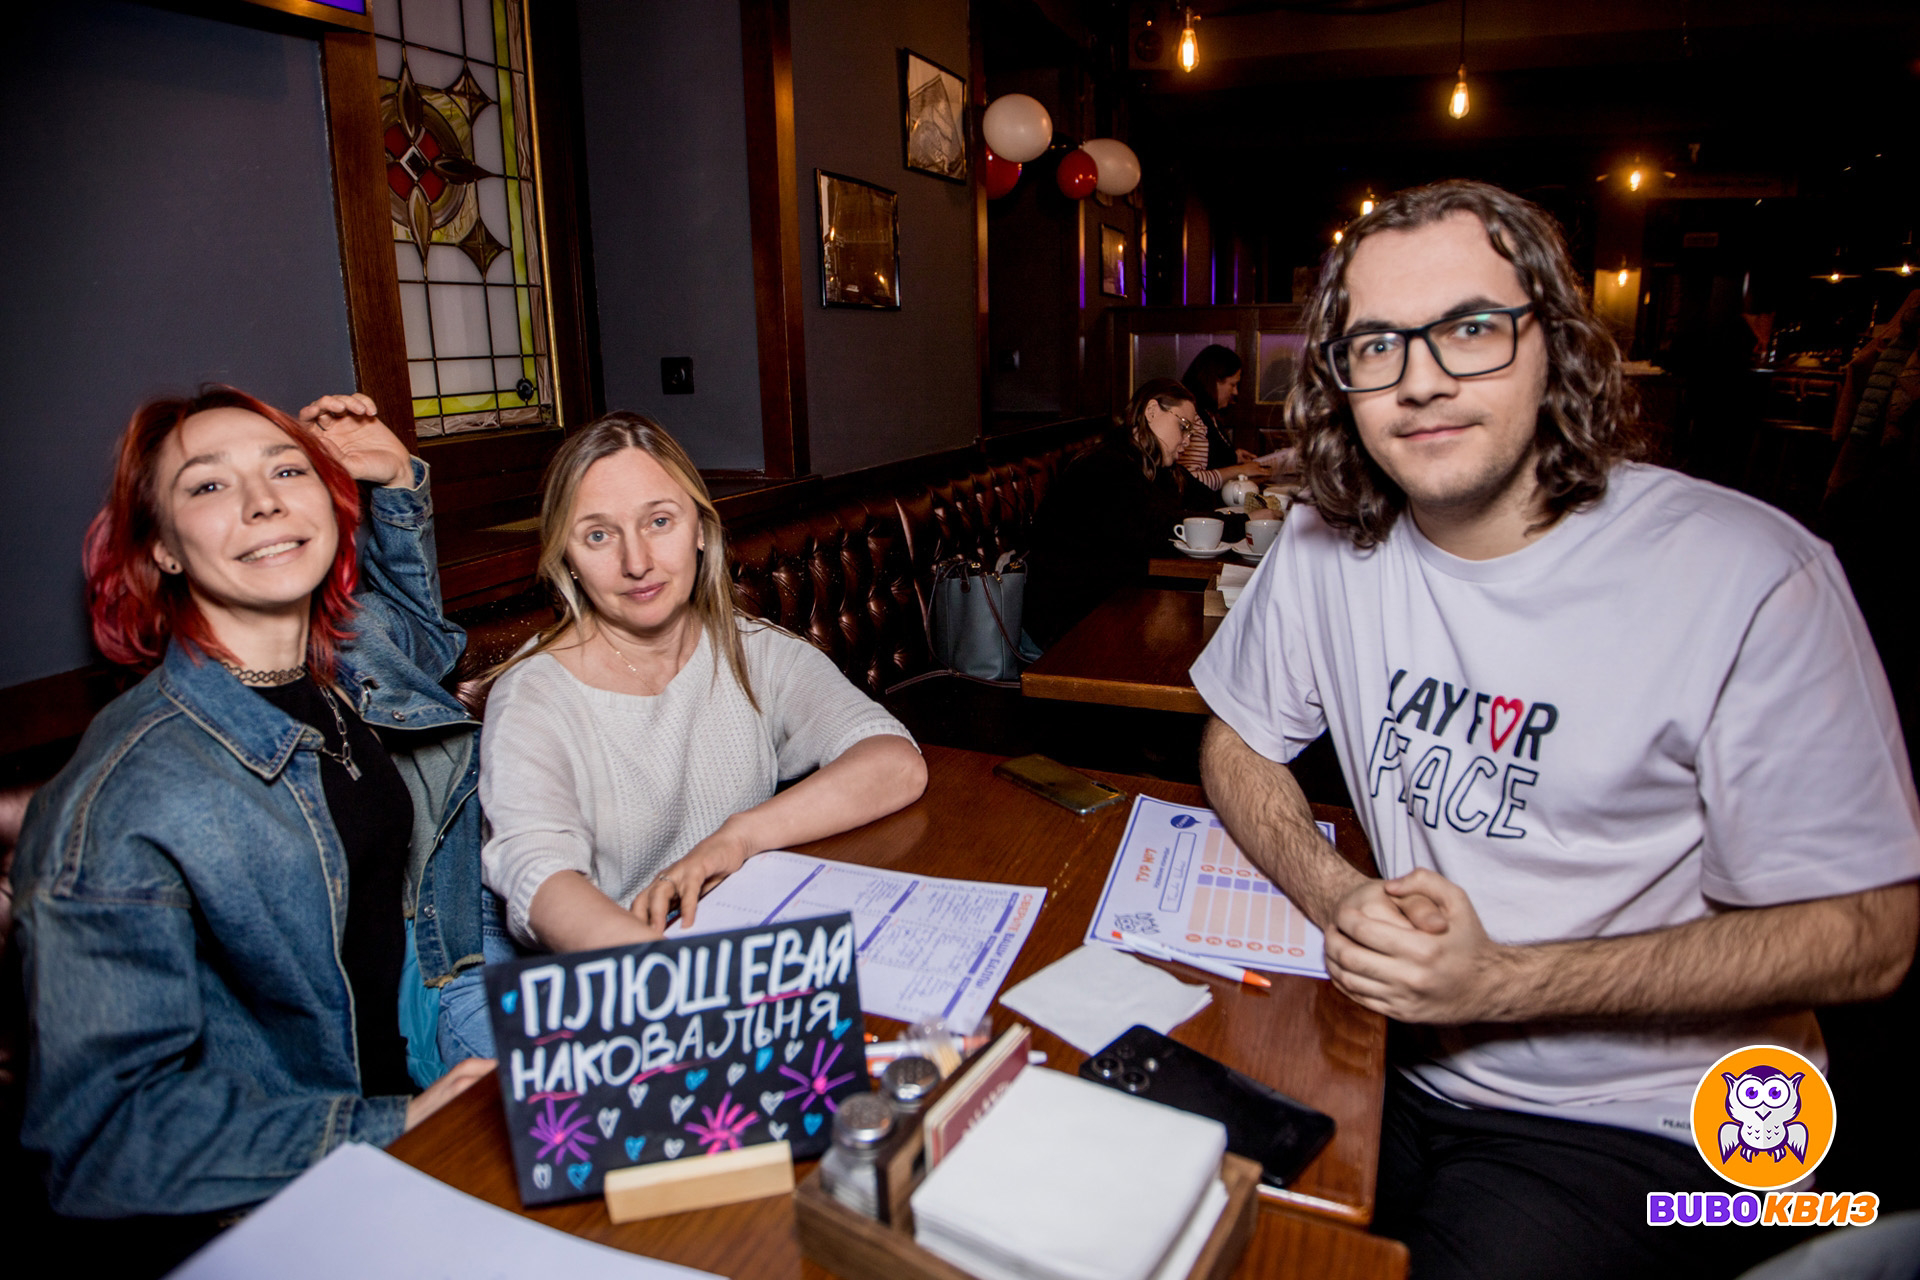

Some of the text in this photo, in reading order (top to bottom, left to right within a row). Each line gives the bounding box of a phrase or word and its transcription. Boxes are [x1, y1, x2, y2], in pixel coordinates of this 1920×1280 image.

[1387, 668, 1469, 736] LAY
[520, 922, 854, 1037] ПЛЮШЕВАЯ
[511, 992, 841, 1101] НАКОВАЛЬНЯ
